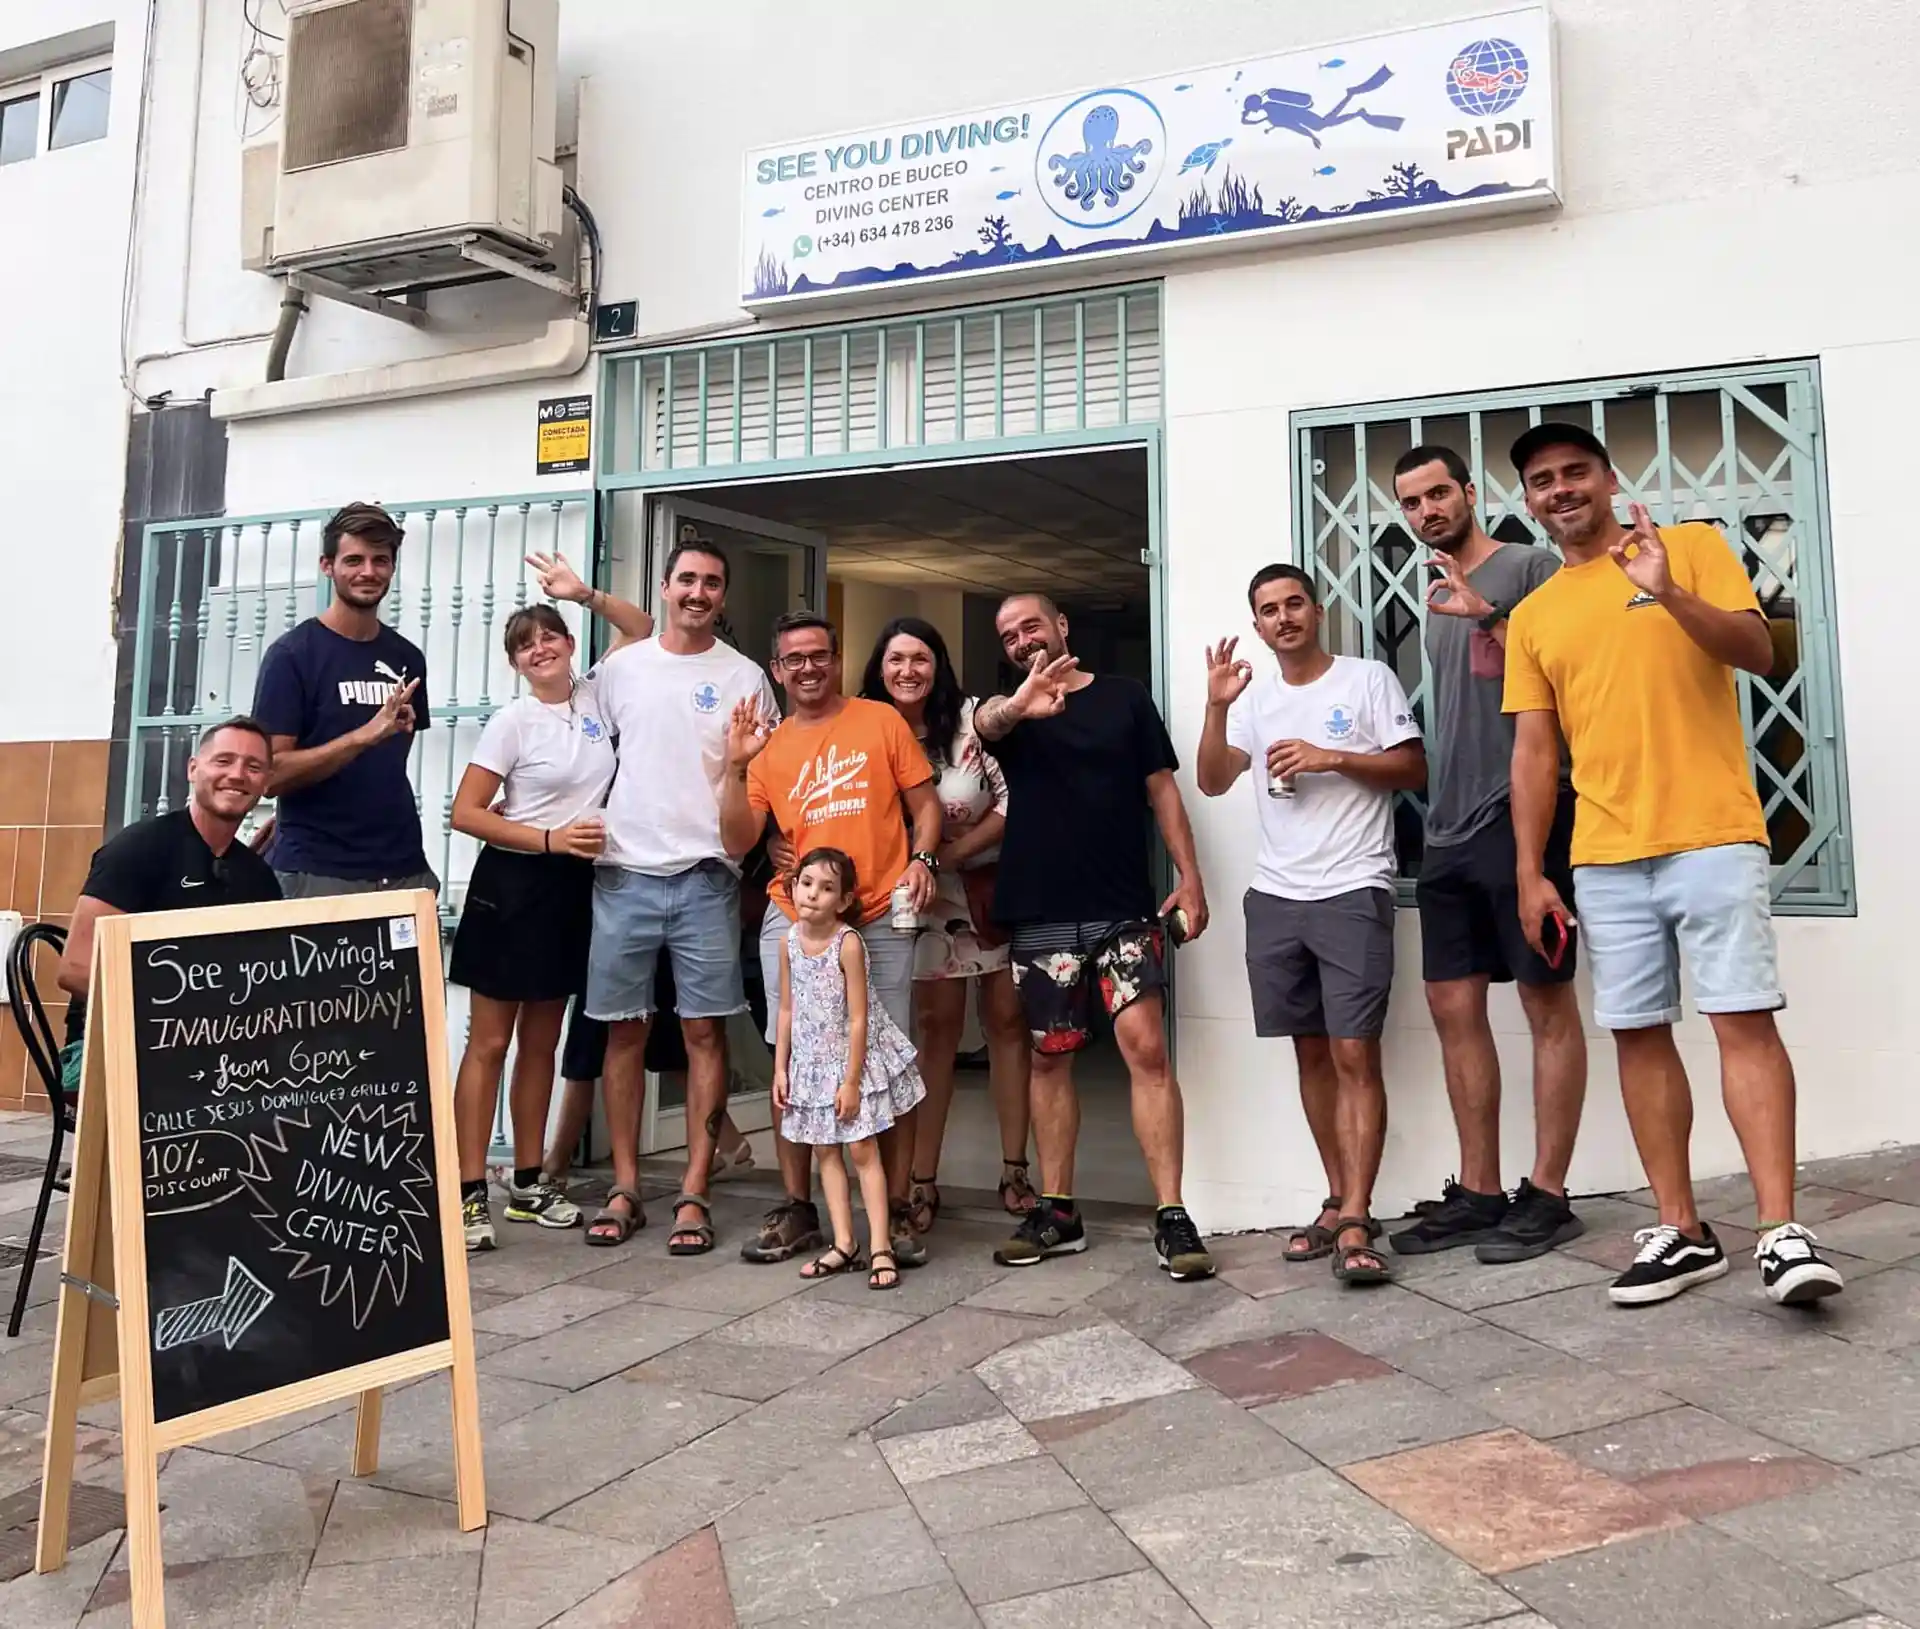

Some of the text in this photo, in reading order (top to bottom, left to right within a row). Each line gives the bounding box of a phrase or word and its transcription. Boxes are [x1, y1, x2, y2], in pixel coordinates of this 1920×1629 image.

[757, 113, 1030, 185] SEE YOU DIVING!
[1446, 119, 1532, 161] PADI
[804, 159, 968, 201] CENTRO DE BUCEO
[815, 188, 949, 224] DIVING CENTER
[817, 214, 954, 252] (+34) 634 478 236
[610, 307, 621, 333] 2
[148, 926, 396, 1005] See you Diving!
[214, 1040, 351, 1089] from 6pm
[143, 1081, 419, 1133] CALLE JESUS DOMINGUEZ GRILLO 2
[146, 1139, 205, 1180] 10%
[321, 1122, 406, 1171] NEW
[145, 1167, 231, 1200] DISCOUNT
[295, 1158, 395, 1216] DIVING
[286, 1207, 399, 1257] CENTER
